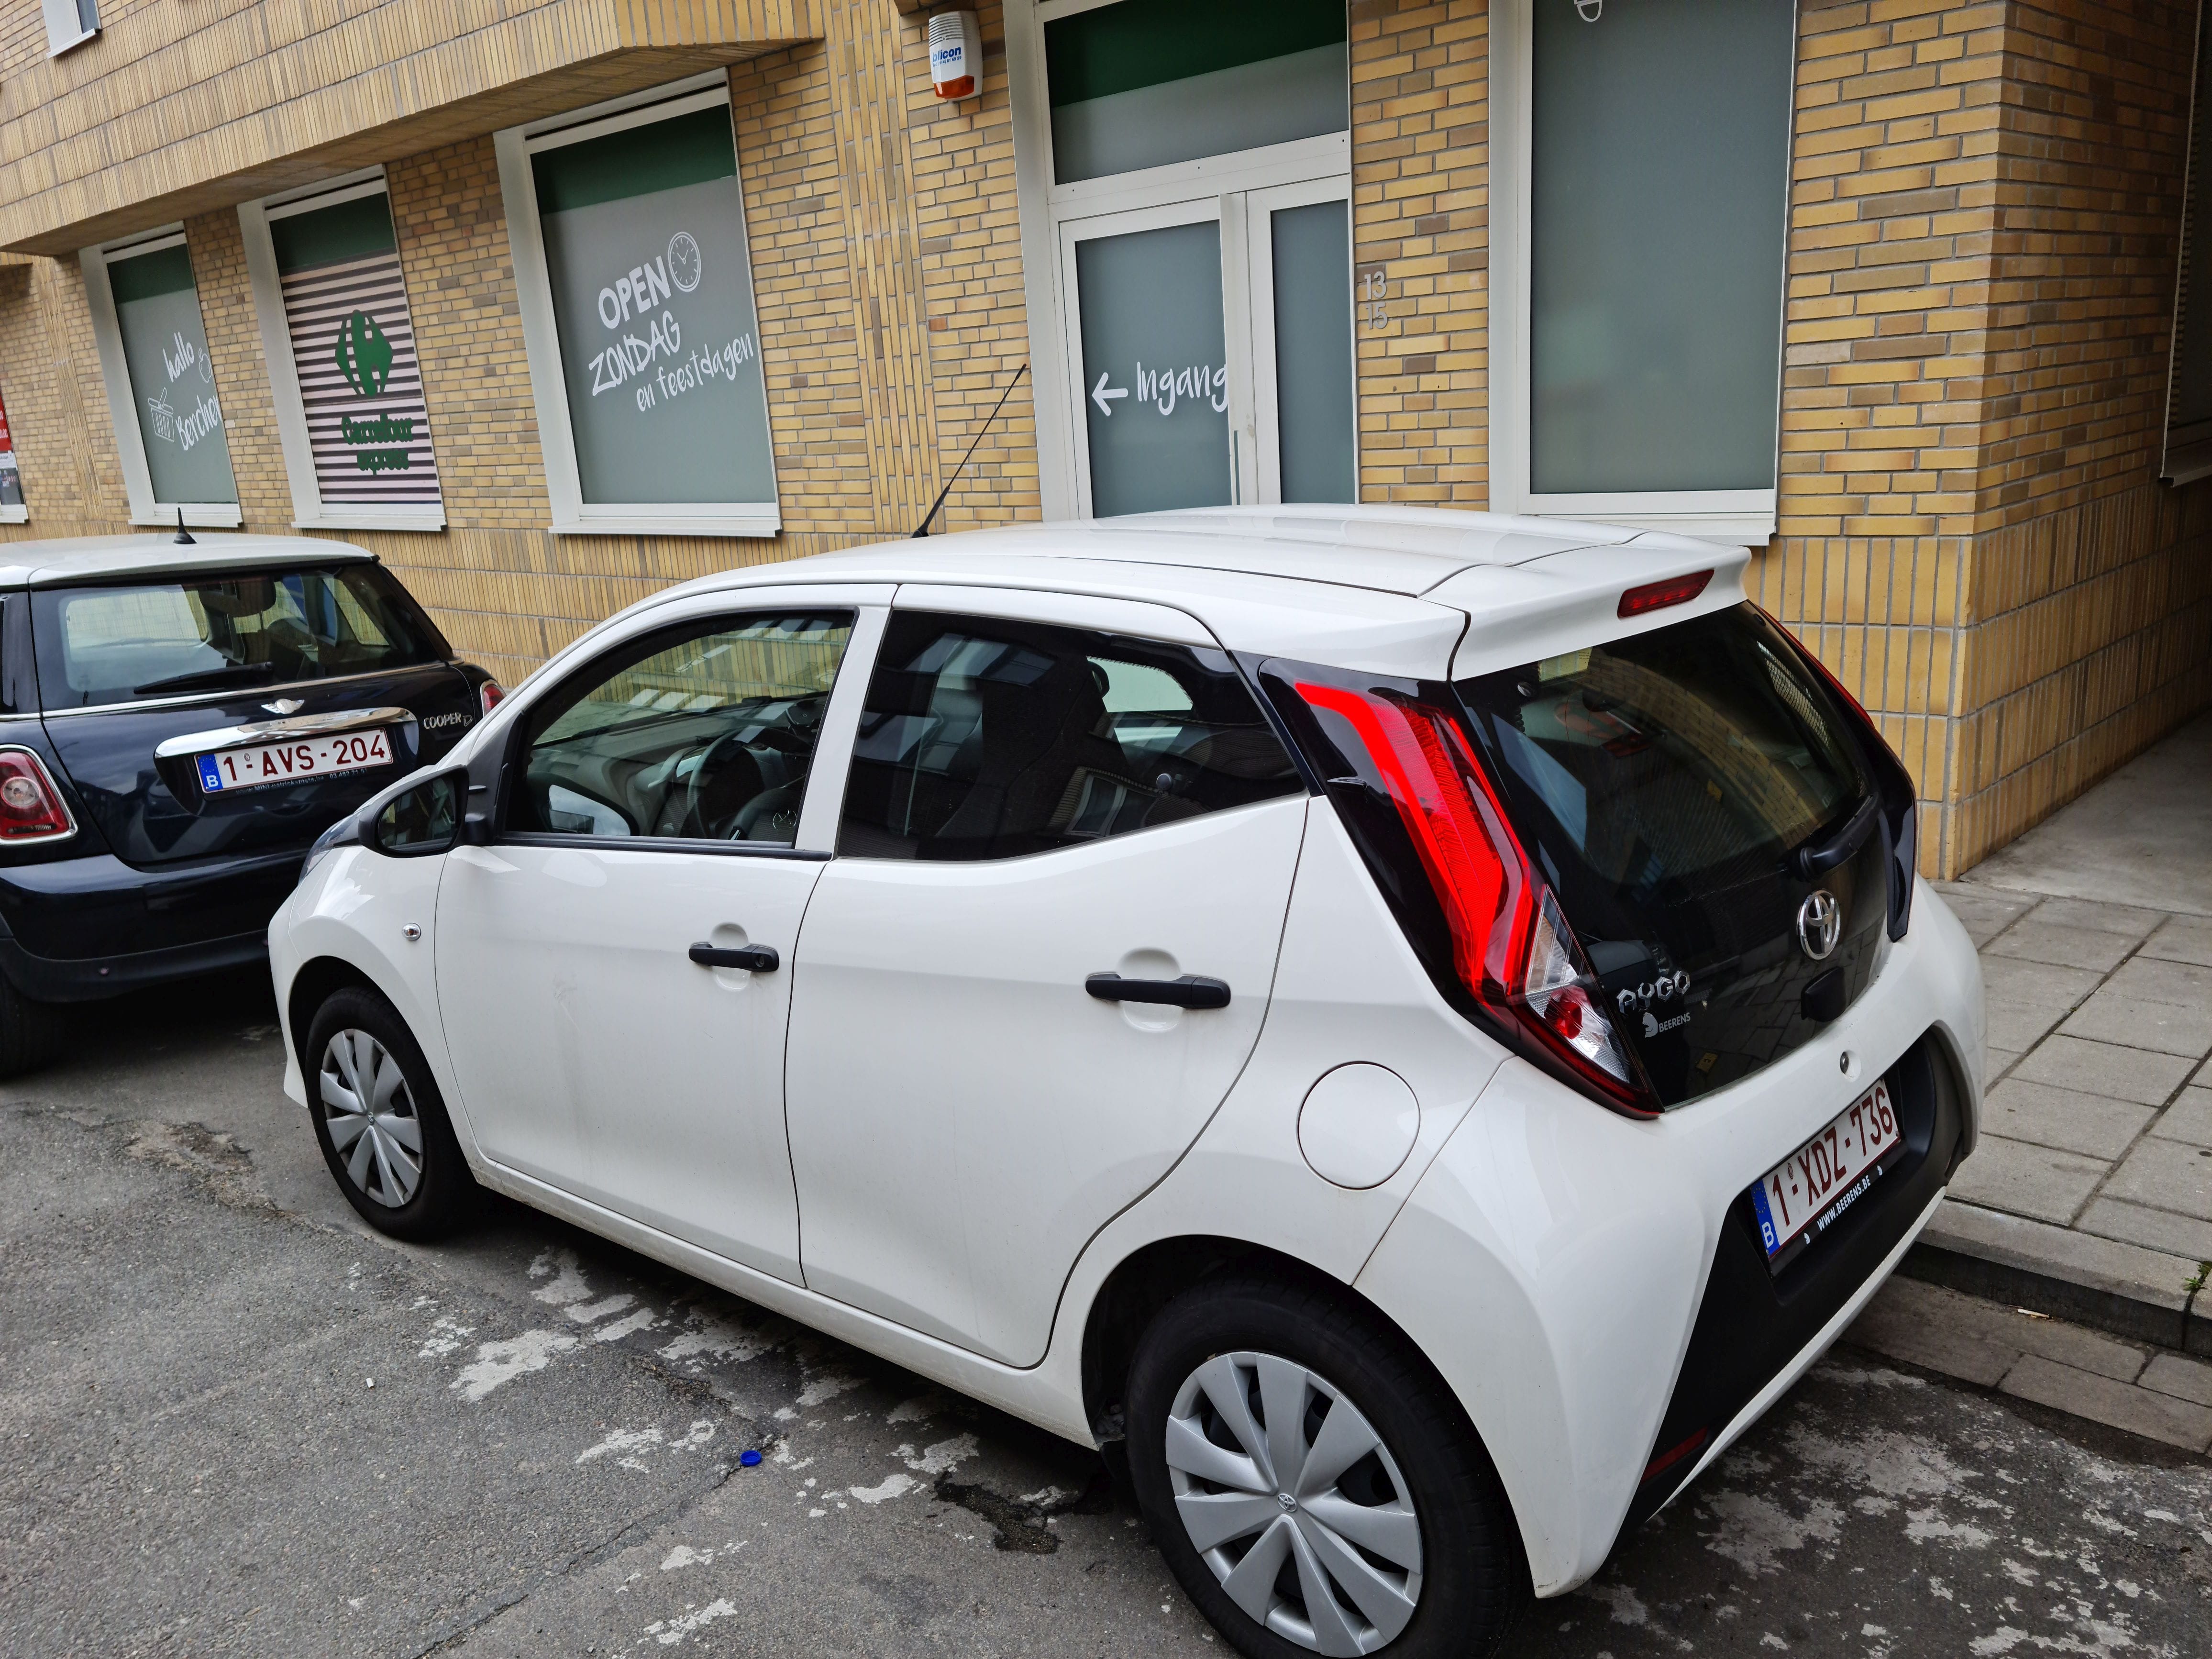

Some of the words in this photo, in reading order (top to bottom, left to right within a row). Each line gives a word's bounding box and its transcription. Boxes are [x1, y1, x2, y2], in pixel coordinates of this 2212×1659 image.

[598, 255, 671, 329] OPEN
[1364, 271, 1386, 300] 13
[1366, 301, 1388, 330] 15
[163, 332, 194, 383] hallo
[589, 310, 680, 397] ZONDAG
[637, 383, 655, 412] en
[656, 333, 754, 399] feestdagen
[1137, 361, 1228, 416] Ingang
[342, 413, 414, 445] Carrefour
[356, 448, 409, 476] express
[423, 712, 462, 730] COOPER
[462, 714, 473, 727] D
[223, 734, 385, 782] 1-AVS-204
[206, 775, 219, 788] B
[1616, 970, 1691, 1015] AYGO
[1659, 1012, 1691, 1033] BEERENS
[1772, 1086, 1893, 1228] 1-XDZ-736
[1817, 1174, 1871, 1231] WWW.BEERENS.BE
[1762, 1221, 1774, 1249] B
